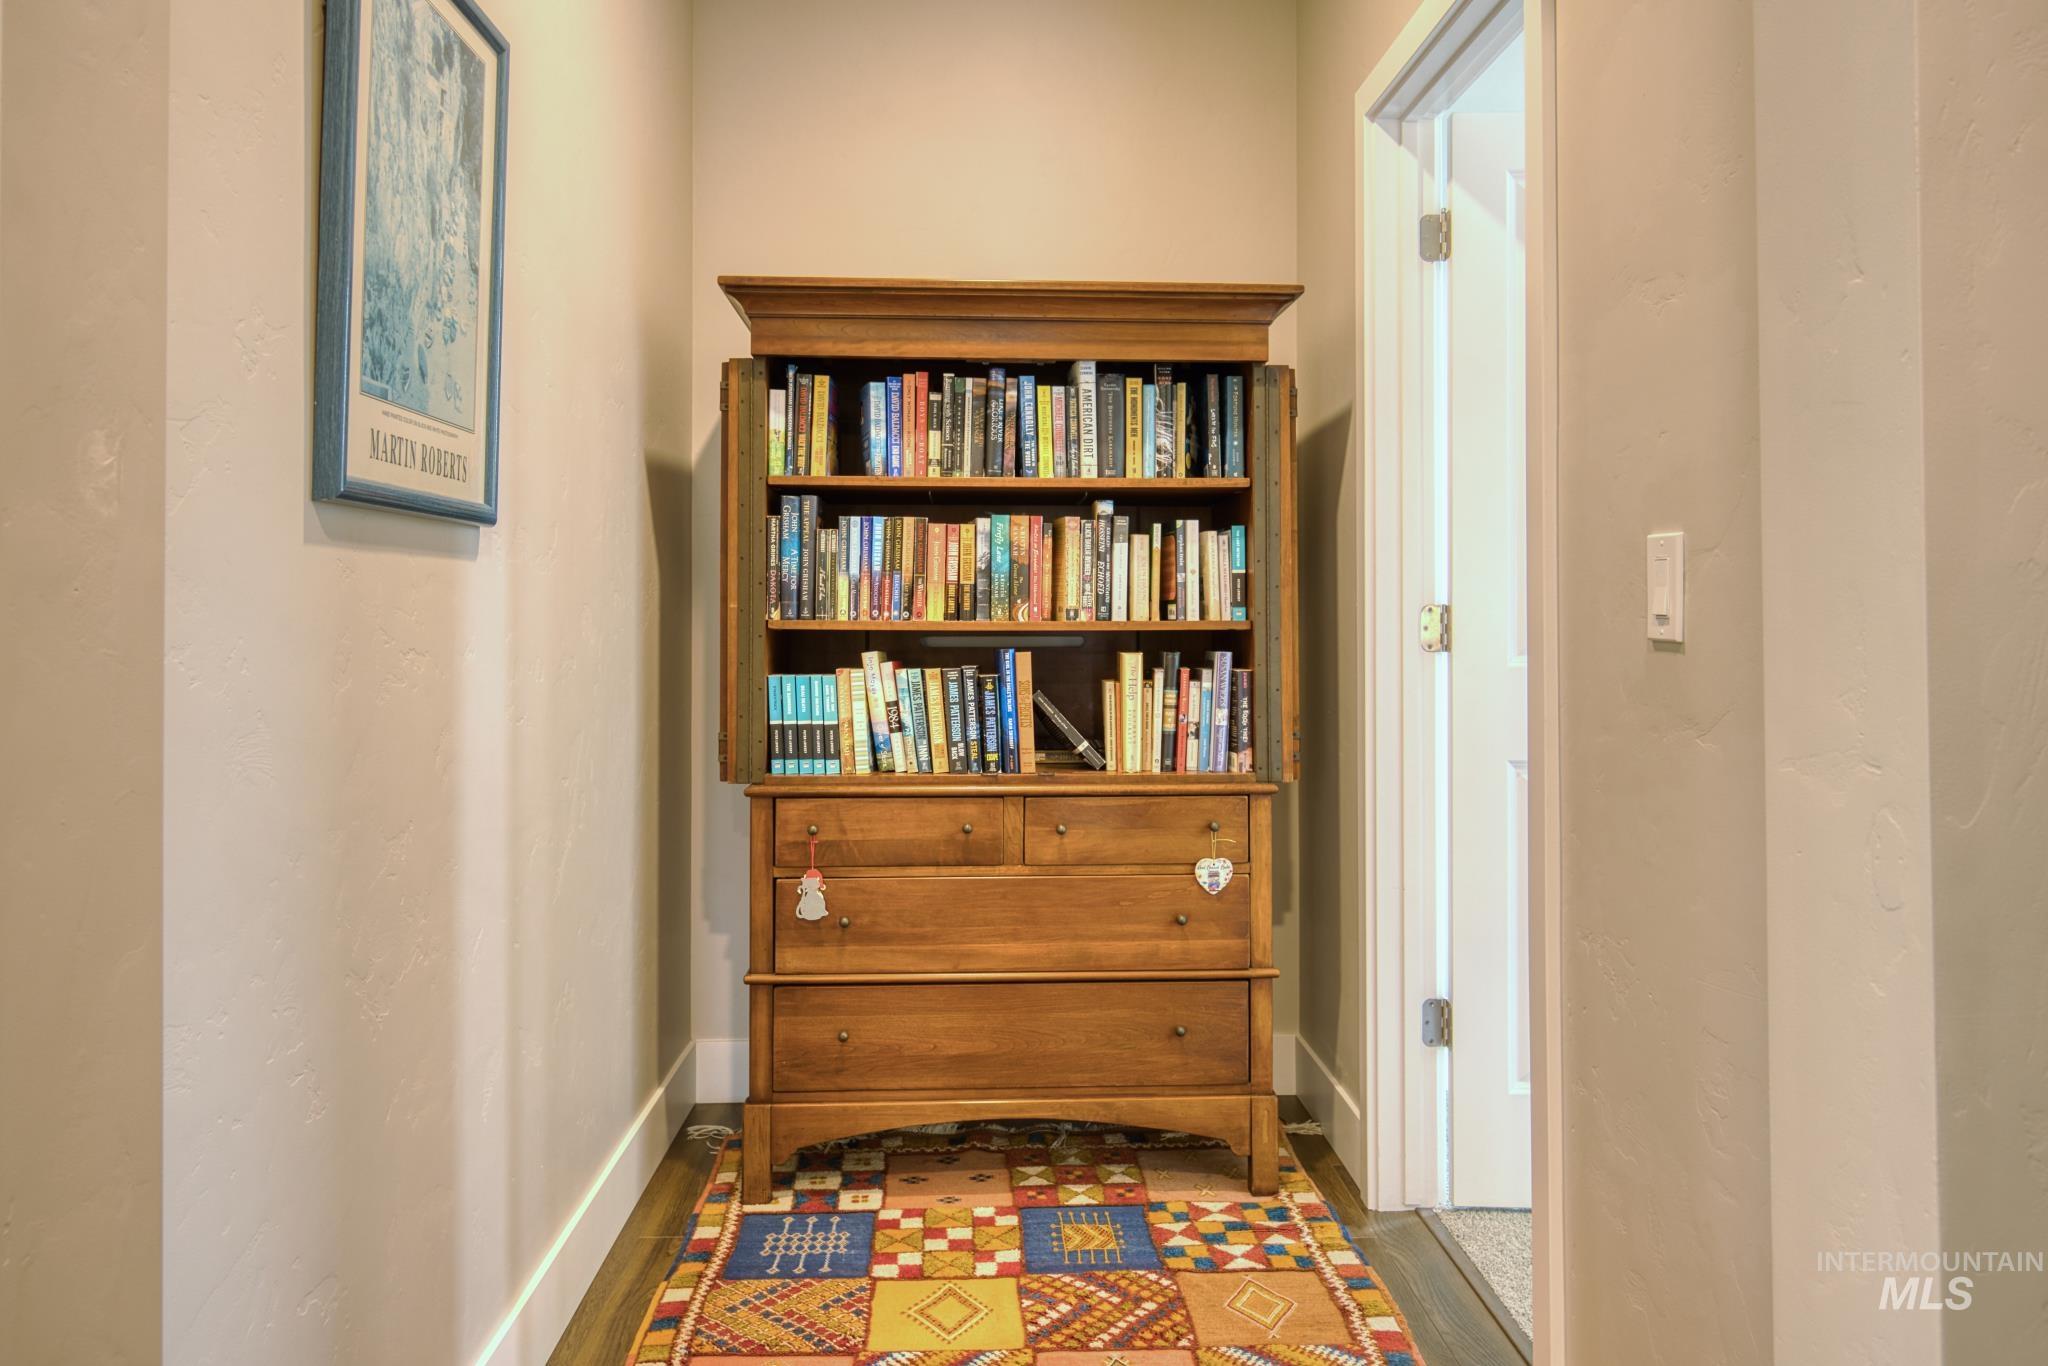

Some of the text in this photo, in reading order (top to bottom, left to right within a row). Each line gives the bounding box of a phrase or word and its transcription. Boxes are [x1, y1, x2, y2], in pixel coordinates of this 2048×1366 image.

[799, 387, 808, 433] DAVID BALDACCI
[816, 391, 825, 410] DAVID
[873, 400, 882, 418] DAVID
[891, 392, 901, 412] DAVID
[1024, 381, 1034, 436] JOHN CONNOLLY
[891, 412, 901, 444] BALDACCI
[944, 418, 952, 441] Scissors
[991, 400, 999, 440] GLORIOUS
[1082, 389, 1094, 459] AMERICAN DIRT
[369, 427, 468, 483] MARTIN ROBERTS
[782, 505, 792, 540] GRISHAM
[791, 512, 799, 533] JOHN
[873, 523, 881, 539] JOHN
[994, 522, 1003, 544] Firefly
[873, 541, 881, 571] GRISHAM
[947, 541, 958, 555] JOHN
[962, 542, 972, 556] JOHN
[781, 557, 790, 583] MERCY
[791, 557, 799, 574] TIME
[947, 556, 958, 581] GRISHAM
[962, 557, 972, 582] GRISHAM
[1097, 561, 1105, 595] ECHOED
[769, 570, 777, 605] DAKOTA
[790, 575, 798, 591] FOR
[1219, 656, 1228, 683] SUSAN
[929, 681, 939, 704] JAMES
[1018, 681, 1031, 696] SONS
[1126, 678, 1138, 701] Help
[948, 682, 961, 742] JAMES PATTERSON
[985, 690, 996, 715] JAMES
[887, 706, 899, 730] 1984
[911, 681, 929, 761] JAMES PATTERSON INN
[932, 705, 945, 744] PATTERSON
[966, 679, 978, 761] JAMES PATTERSON STEAL
[985, 716, 998, 752] PATTERSON
